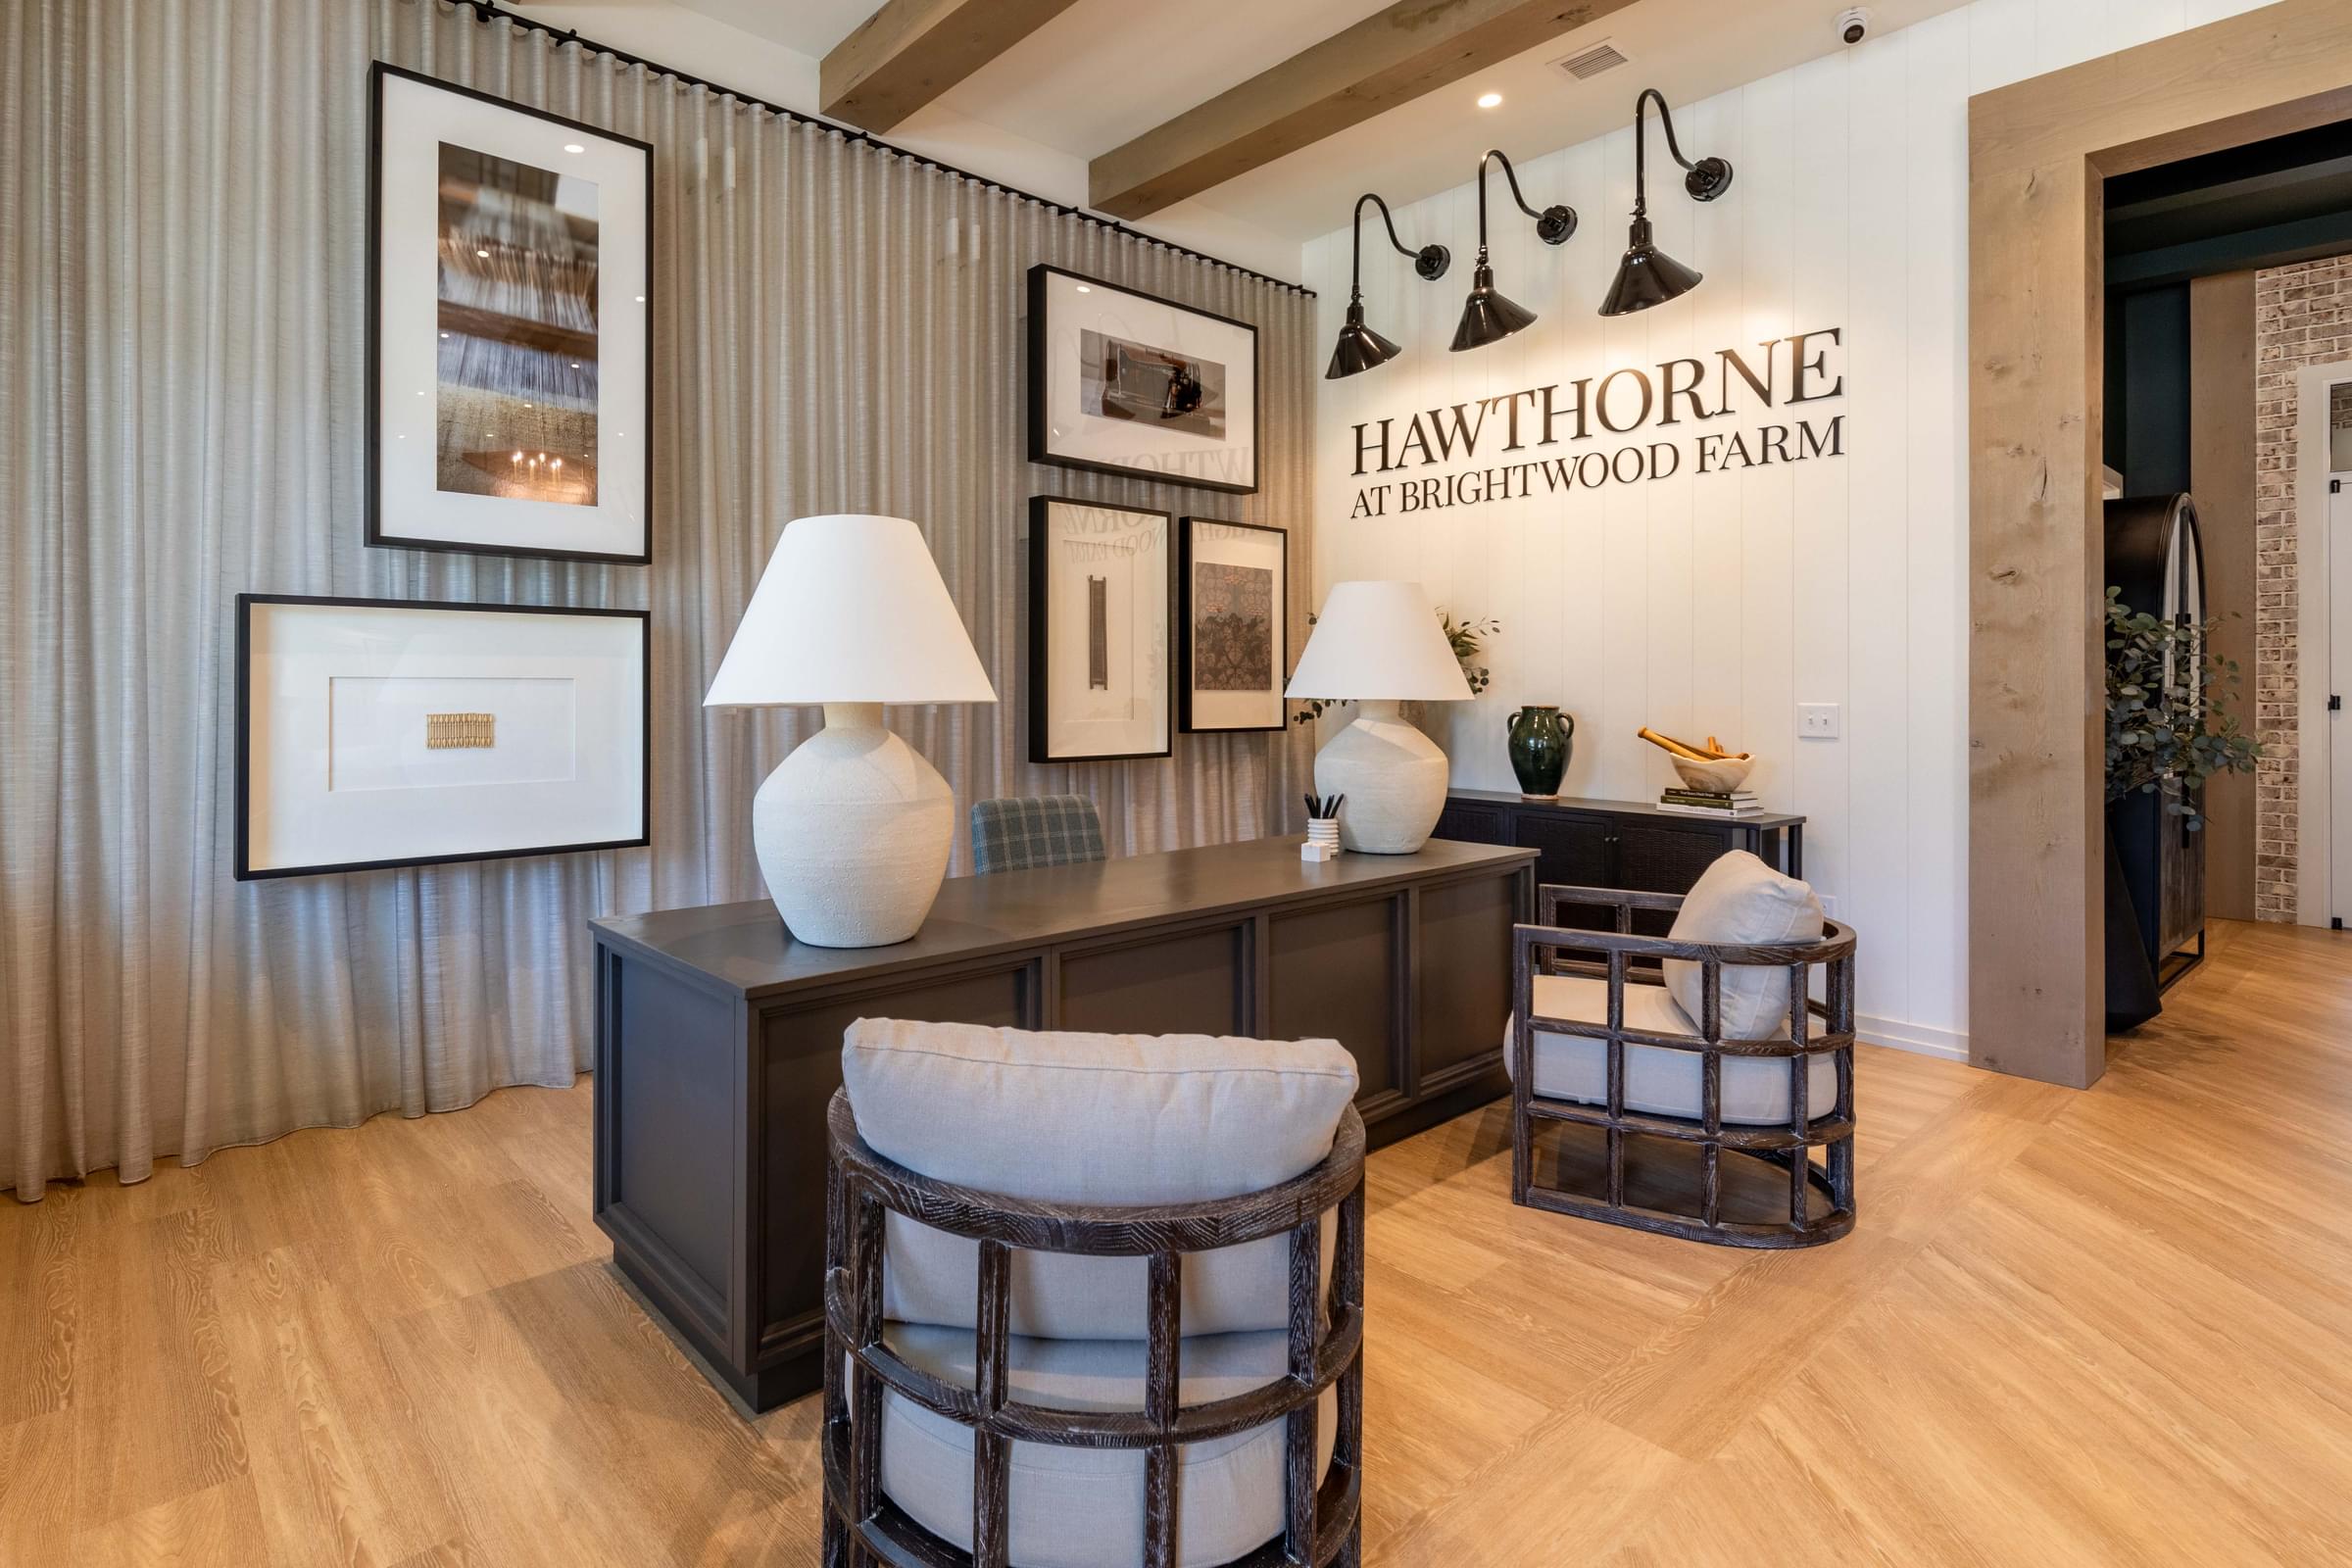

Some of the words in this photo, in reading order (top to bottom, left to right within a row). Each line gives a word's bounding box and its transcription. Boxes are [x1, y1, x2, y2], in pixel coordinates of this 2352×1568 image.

[1349, 326, 1843, 476] HAWTHORNE
[1349, 484, 1392, 519] AT
[1399, 442, 1680, 514] BRIGHTWOOD
[1695, 415, 1846, 474] FARM
